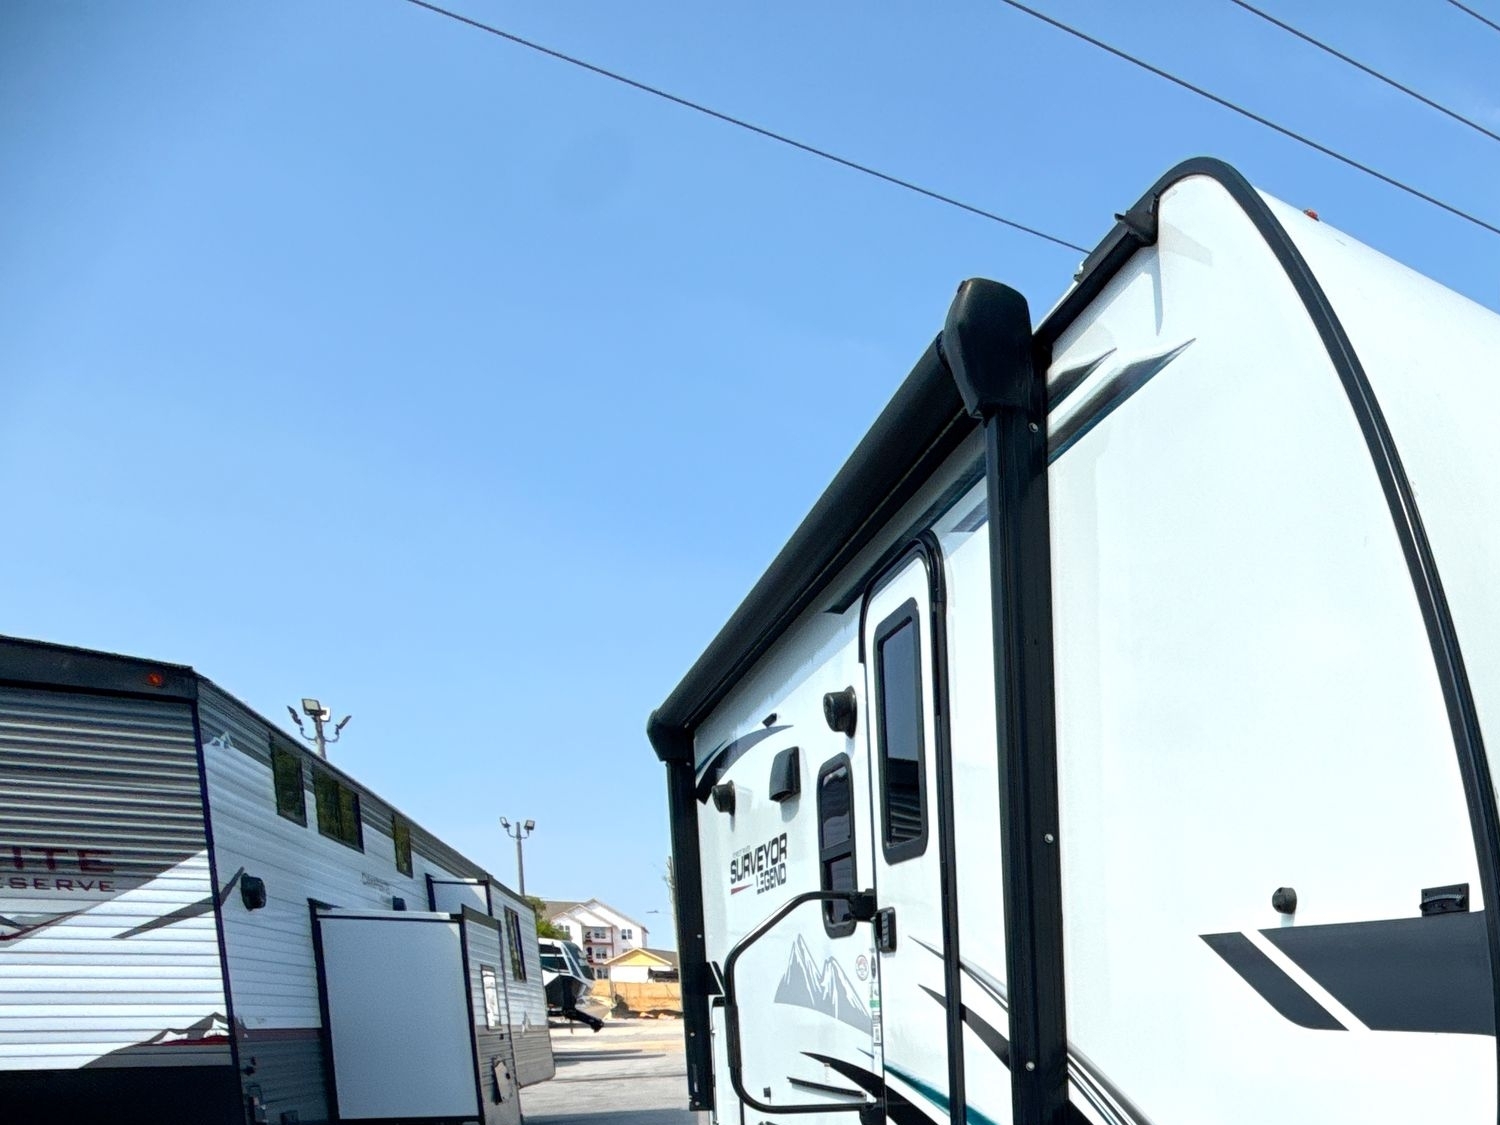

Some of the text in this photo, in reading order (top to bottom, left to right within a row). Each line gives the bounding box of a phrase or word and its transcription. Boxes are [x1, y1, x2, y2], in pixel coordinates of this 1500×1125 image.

[731, 832, 787, 885] SURVEYOR
[0, 877, 116, 892] SERVE
[756, 862, 787, 895] LEGEND
